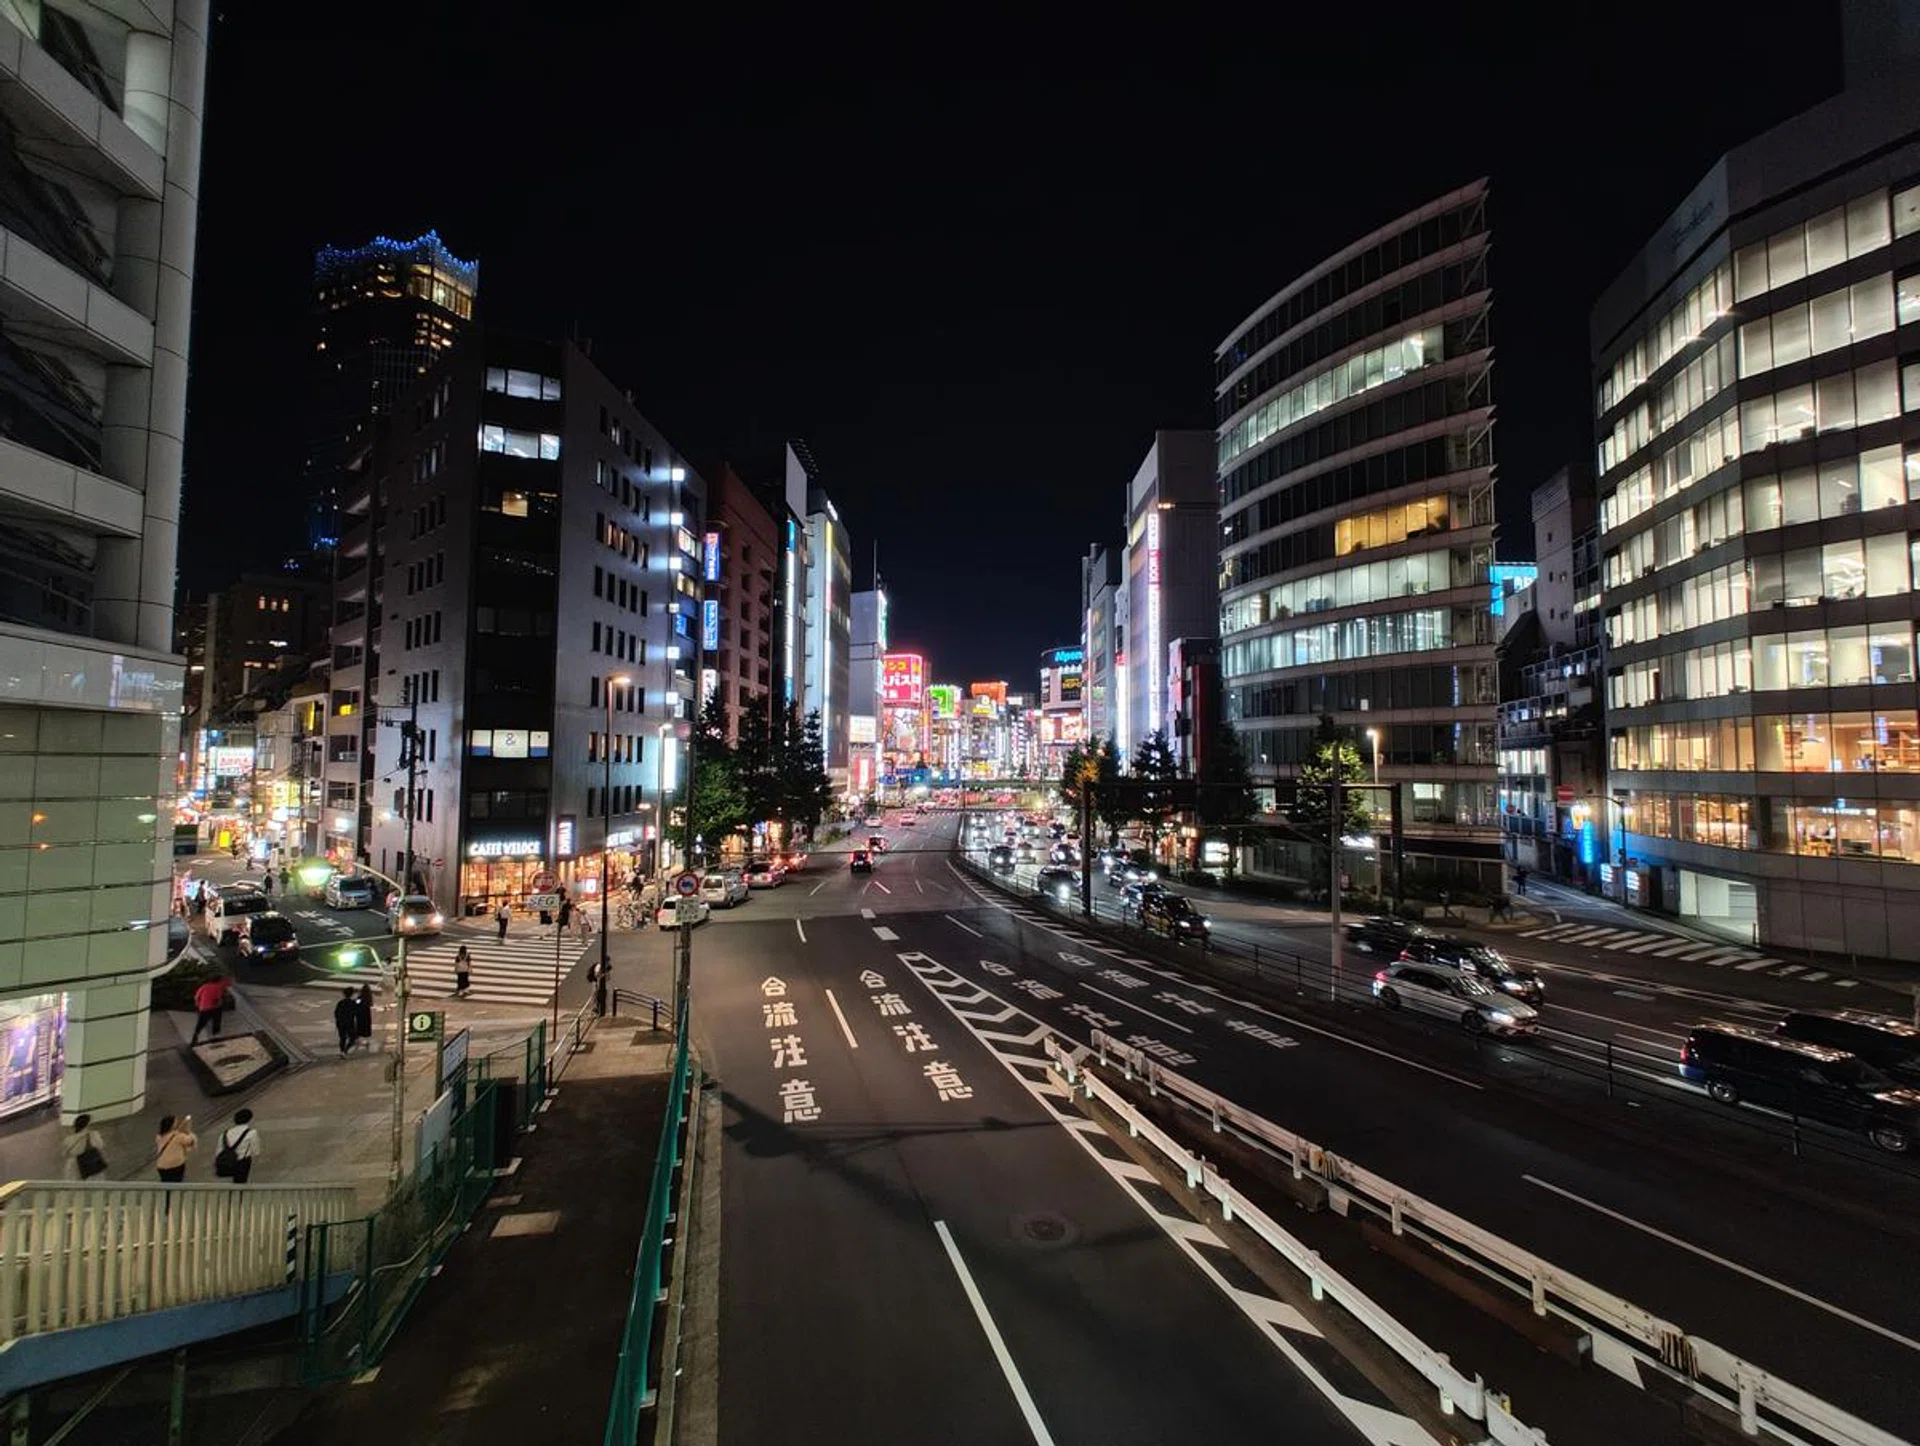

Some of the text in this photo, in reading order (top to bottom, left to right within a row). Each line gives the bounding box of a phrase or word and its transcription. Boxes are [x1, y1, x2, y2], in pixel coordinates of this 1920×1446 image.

[761, 976, 822, 1124] 合流注意
[860, 969, 975, 1101] 合流注意
[979, 960, 1198, 1067] 合流注意
